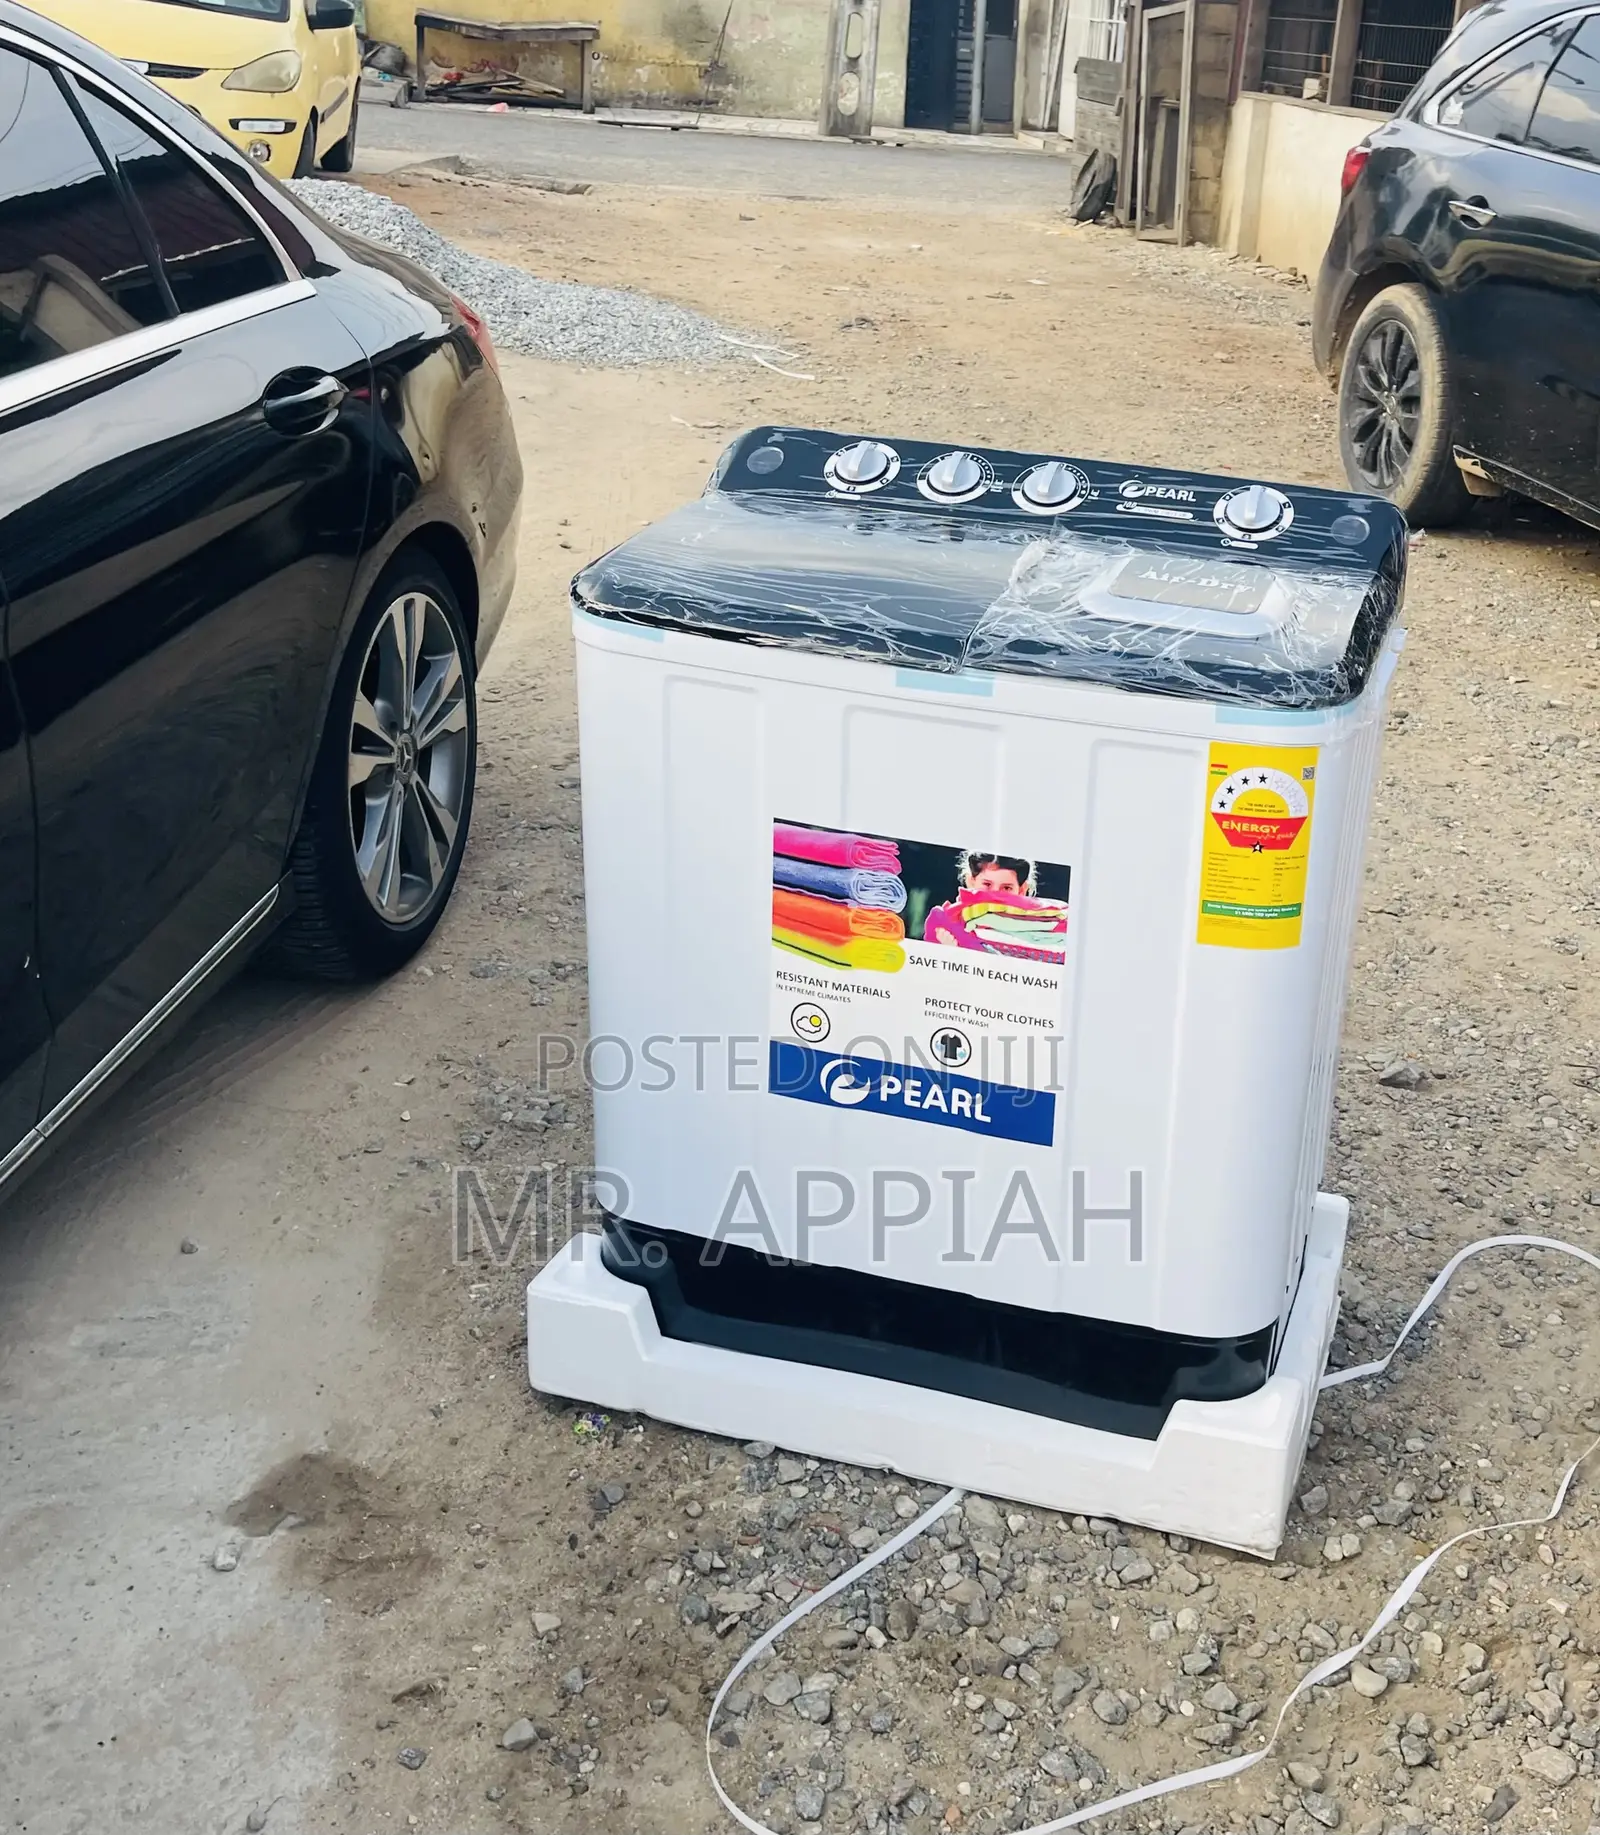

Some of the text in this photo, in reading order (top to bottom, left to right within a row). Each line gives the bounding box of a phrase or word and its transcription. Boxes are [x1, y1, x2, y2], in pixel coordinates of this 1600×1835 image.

[1144, 486, 1197, 502] PEARL
[1221, 820, 1280, 833] ENERGY
[776, 970, 891, 999] RESISTANT MATERIALS
[909, 955, 1058, 990] SAVE TIME IN EACH WASH
[776, 983, 852, 1003] IN EXTREME CLIMATES
[924, 997, 1055, 1029] PROTECT YOUR CLOTHES
[924, 1010, 989, 1029] EFFICIENTLY WASH
[880, 1075, 992, 1123] PEARL
